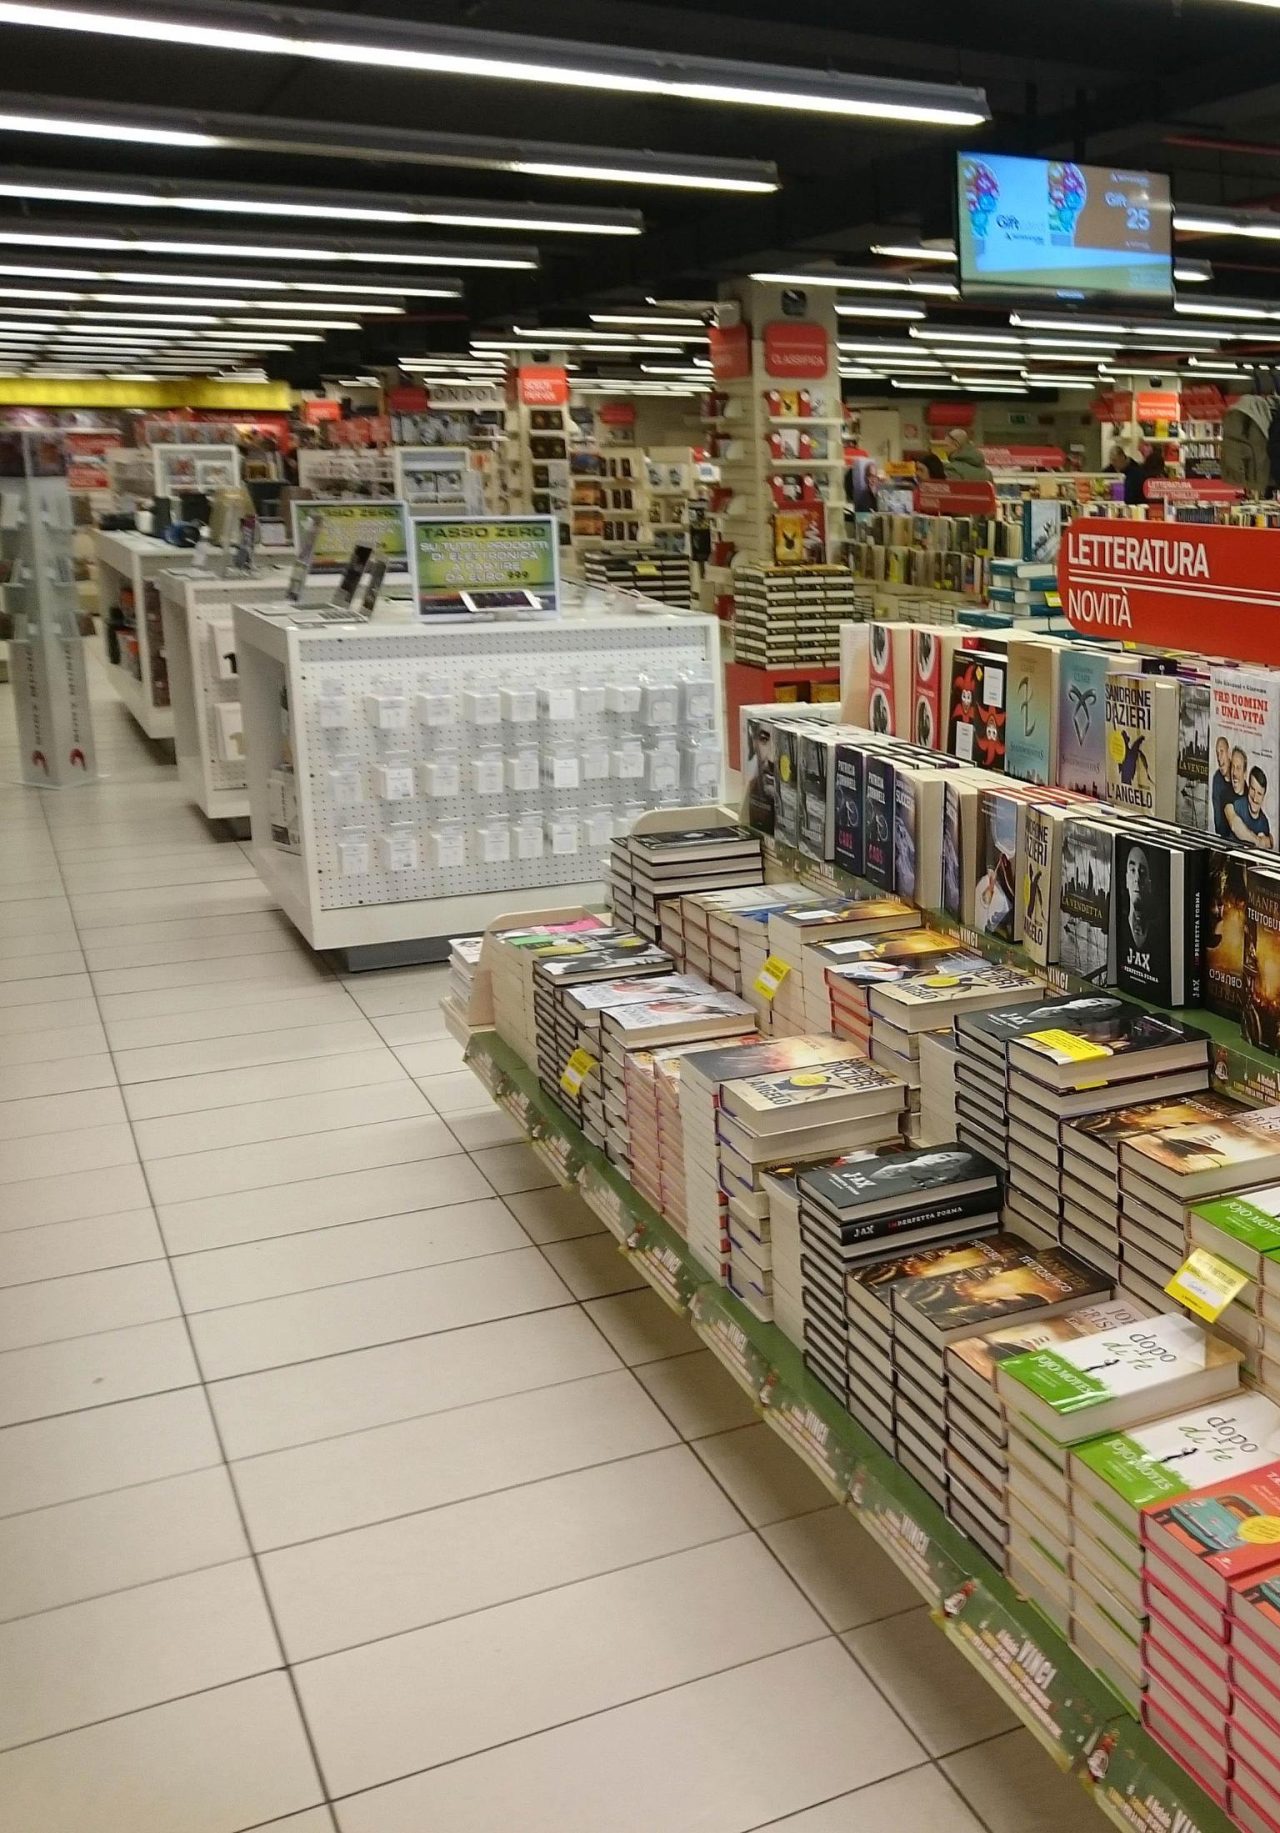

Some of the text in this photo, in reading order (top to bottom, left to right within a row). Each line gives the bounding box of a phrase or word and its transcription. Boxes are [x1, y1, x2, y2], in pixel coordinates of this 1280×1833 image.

[1127, 208, 1150, 230] 25
[422, 526, 546, 539] TASSO ZERO
[420, 542, 436, 551] SU
[1068, 533, 1210, 579] LETTERATURA
[1067, 587, 1133, 629] NOVITÀ
[1105, 683, 1151, 708] SANDRONE
[1214, 690, 1269, 713] TRE UOMINI
[1105, 702, 1151, 731] DAZIERI
[1221, 707, 1240, 720] UNA
[1241, 711, 1265, 726] VITA
[1107, 783, 1153, 809] L'ANGELO
[1062, 895, 1103, 919] LA VENDETTA
[960, 929, 978, 948] VINCI
[1047, 967, 1069, 990] VINCI
[821, 1060, 880, 1091] DAZIERI
[848, 1058, 895, 1088] SANDRONE
[936, 1206, 963, 1218] FORMA
[1018, 1254, 1073, 1294] TEUTOBURGO
